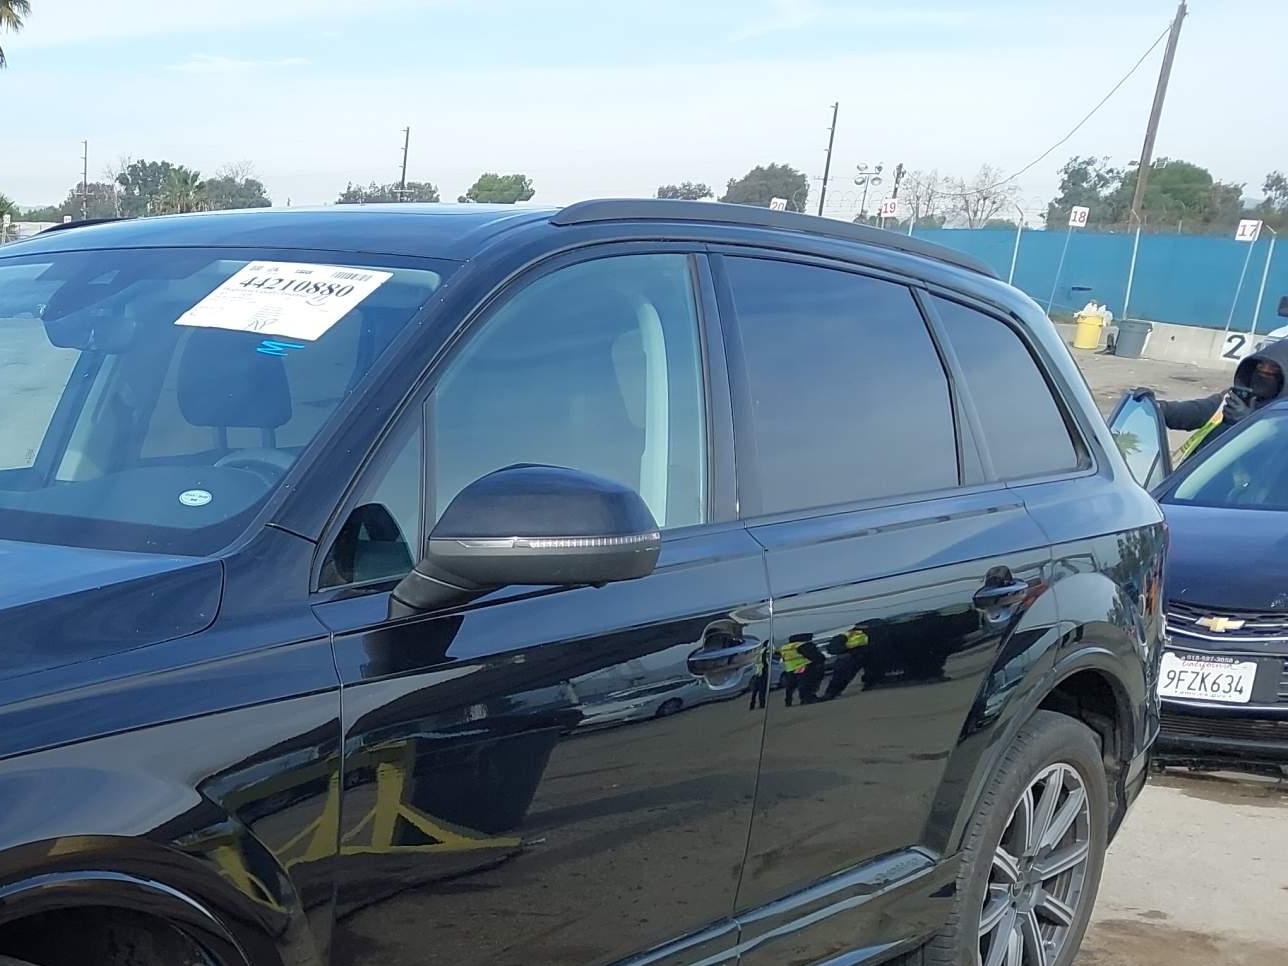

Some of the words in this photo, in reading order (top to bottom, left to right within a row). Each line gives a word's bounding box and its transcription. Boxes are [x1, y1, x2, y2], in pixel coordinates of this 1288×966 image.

[882, 202, 896, 214] 19
[1072, 210, 1087, 223] 18
[1238, 224, 1257, 237] 17
[239, 276, 355, 298] 44210880
[1163, 670, 1244, 695] 9FZK634
